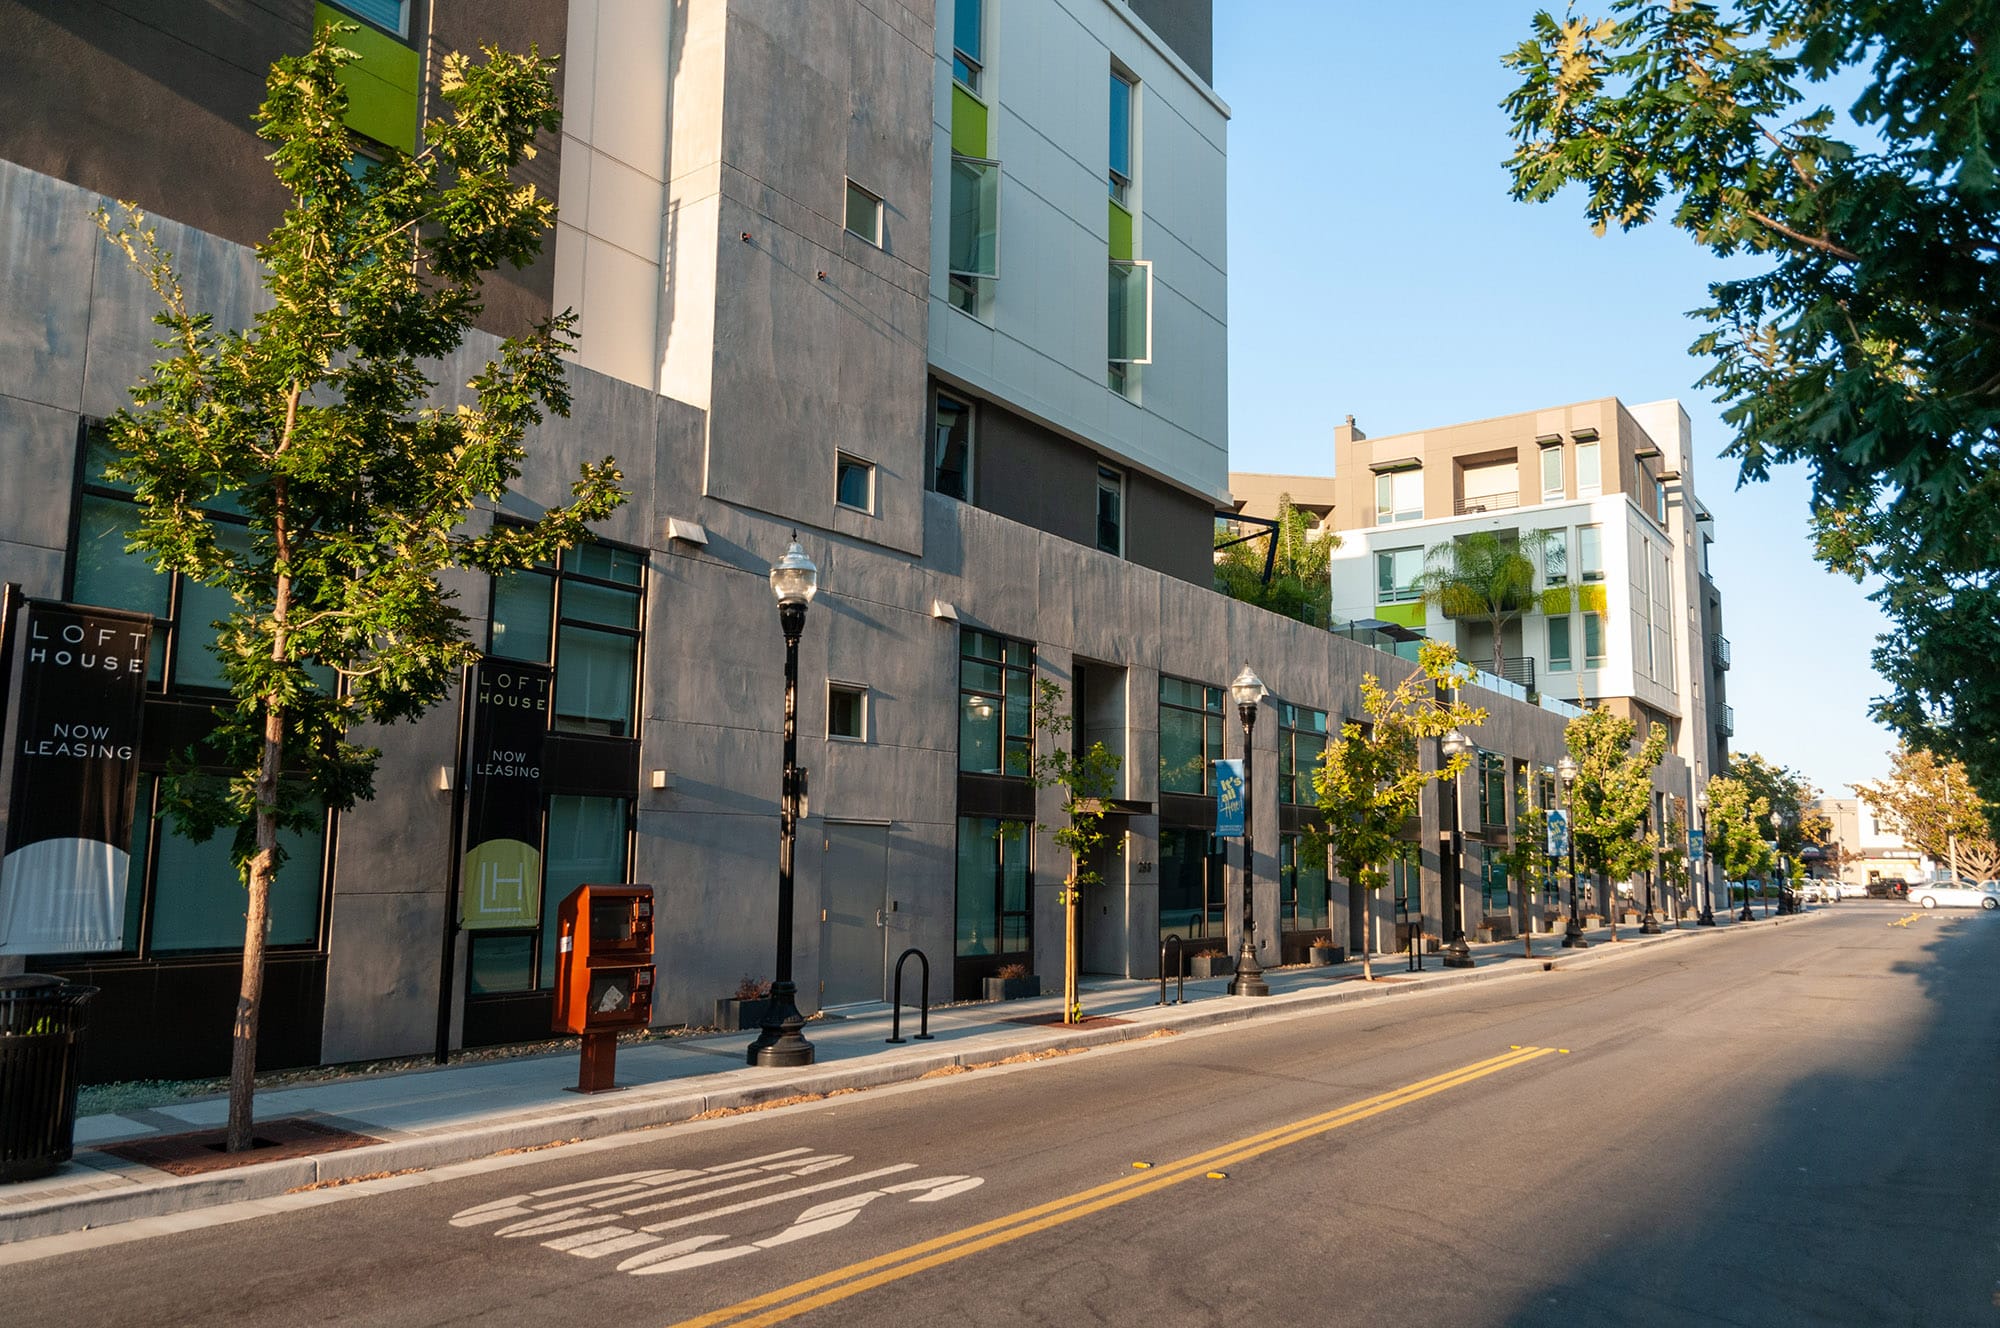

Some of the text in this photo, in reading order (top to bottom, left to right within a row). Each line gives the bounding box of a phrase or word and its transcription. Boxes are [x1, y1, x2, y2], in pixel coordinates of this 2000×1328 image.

[33, 620, 146, 650] LOFT
[30, 647, 144, 673] HOUSE
[481, 671, 547, 692] LOFT
[480, 692, 545, 710] HOUSE
[53, 723, 110, 740] NOW
[24, 740, 133, 760] LEASING
[493, 750, 526, 763] NOW
[477, 763, 540, 779] LEASING
[480, 862, 523, 913] LH
[449, 1147, 985, 1275] STOP
